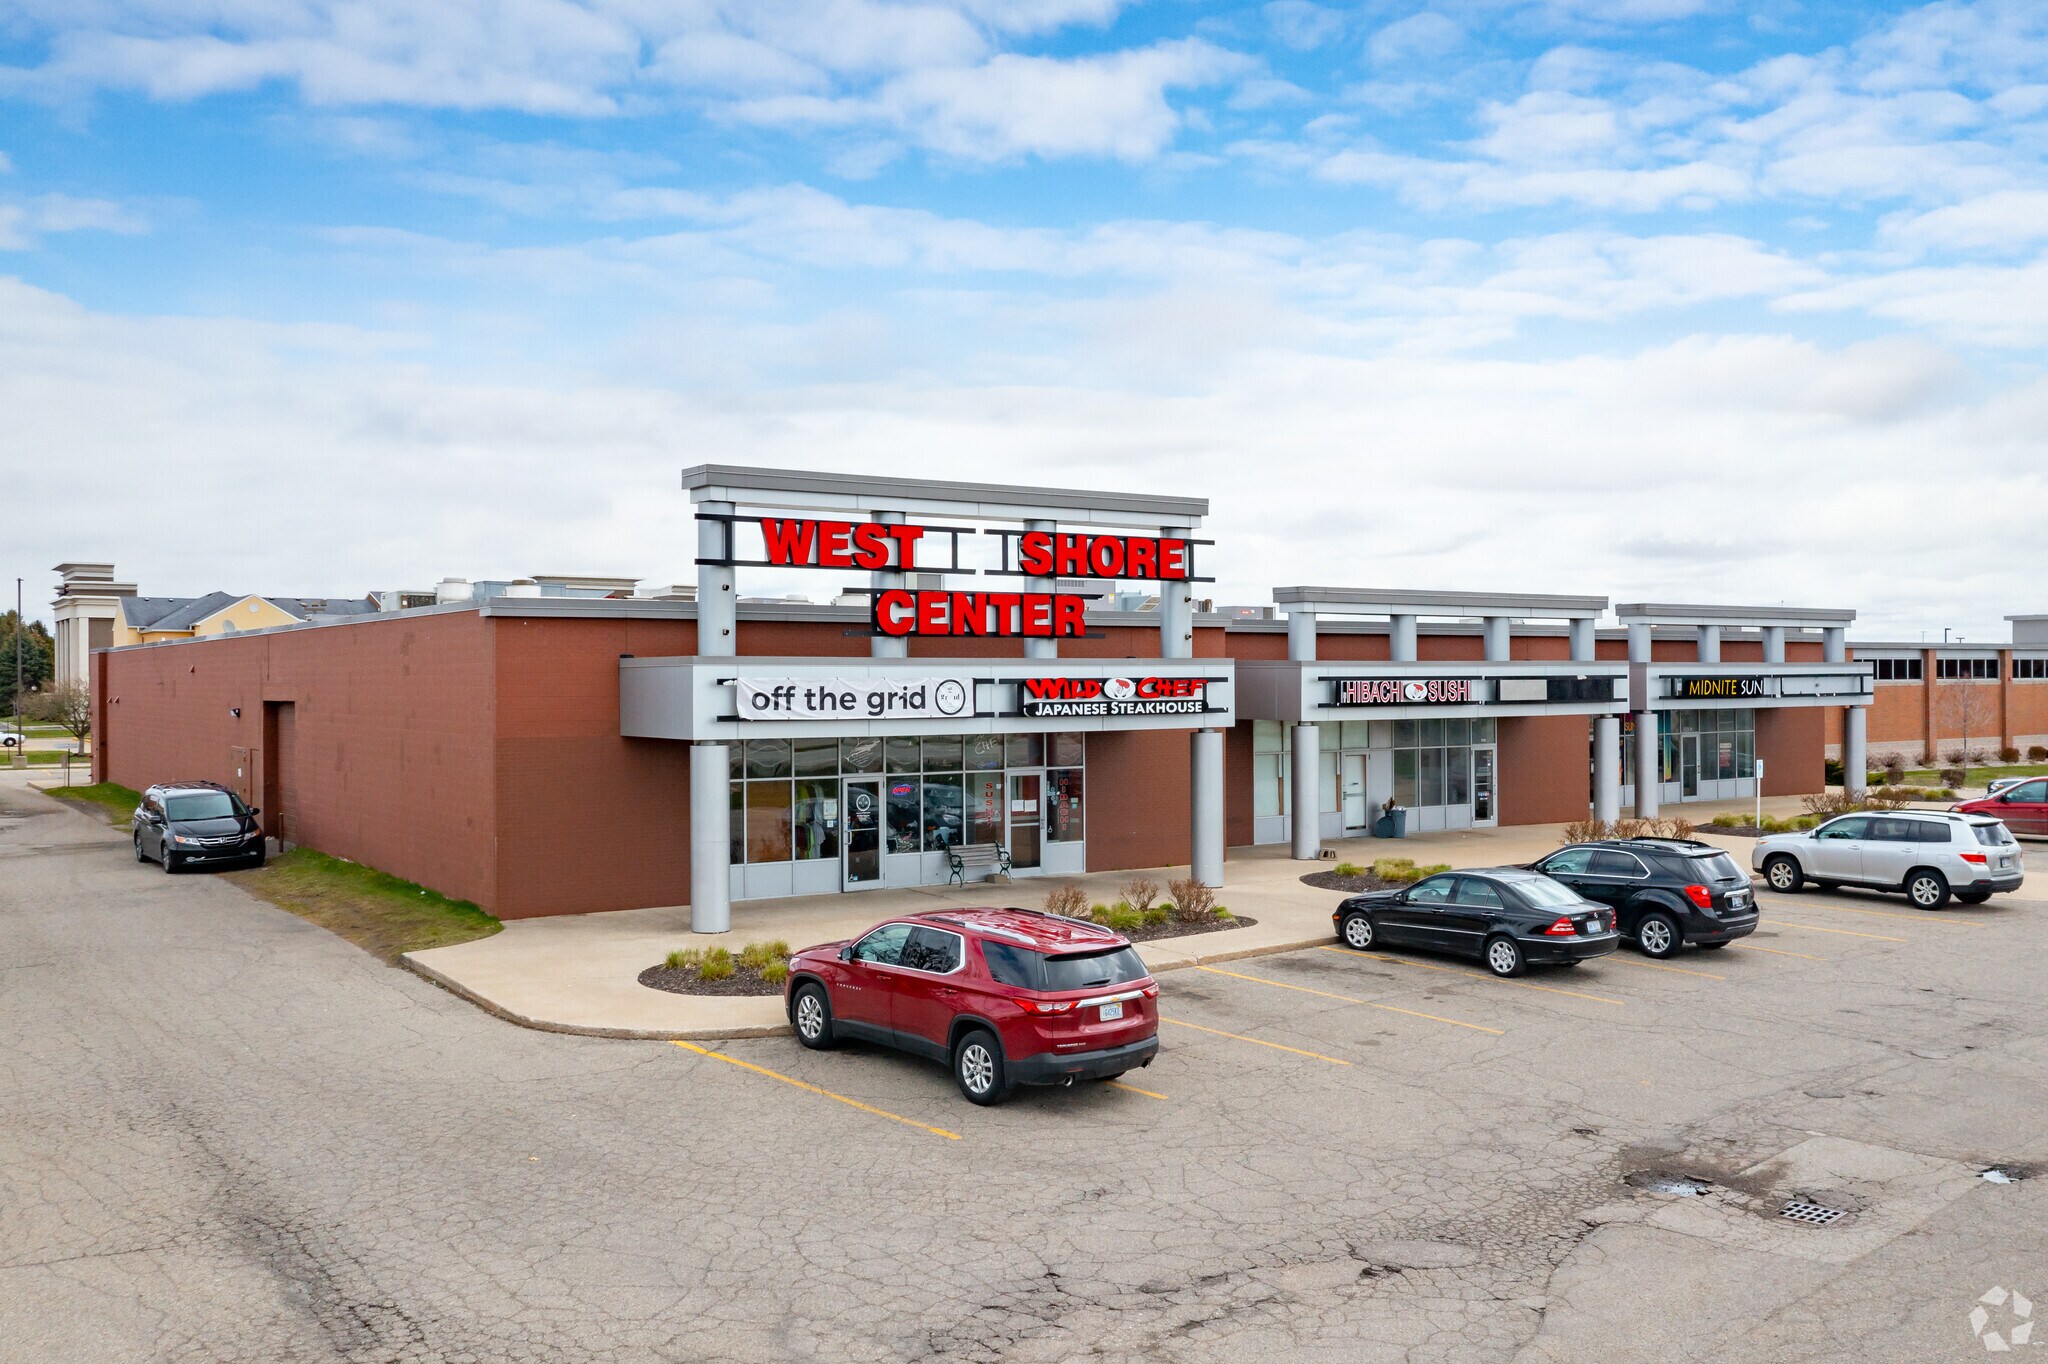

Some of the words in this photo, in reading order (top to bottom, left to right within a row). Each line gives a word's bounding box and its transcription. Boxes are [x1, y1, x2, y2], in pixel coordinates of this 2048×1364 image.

[761, 517, 924, 570] WEST
[1020, 531, 1185, 579] SHORE
[877, 589, 1087, 637] CENTER
[751, 685, 796, 711] off
[804, 685, 857, 711] the
[866, 685, 926, 717] grid
[1025, 677, 1101, 699] WILD
[1137, 677, 1208, 699] CHEF
[1346, 680, 1405, 703] HIBACHI
[1427, 680, 1471, 702] SUSHI
[1689, 679, 1737, 696] MIDNITE
[1741, 679, 1763, 695] SUN
[1035, 702, 1107, 716] JAPANESE
[1110, 701, 1202, 714] STEAKHOUSE
[892, 785, 911, 794] OPEN
[985, 782, 994, 826] SUSHI
[1060, 778, 1069, 831] HIBACHI
